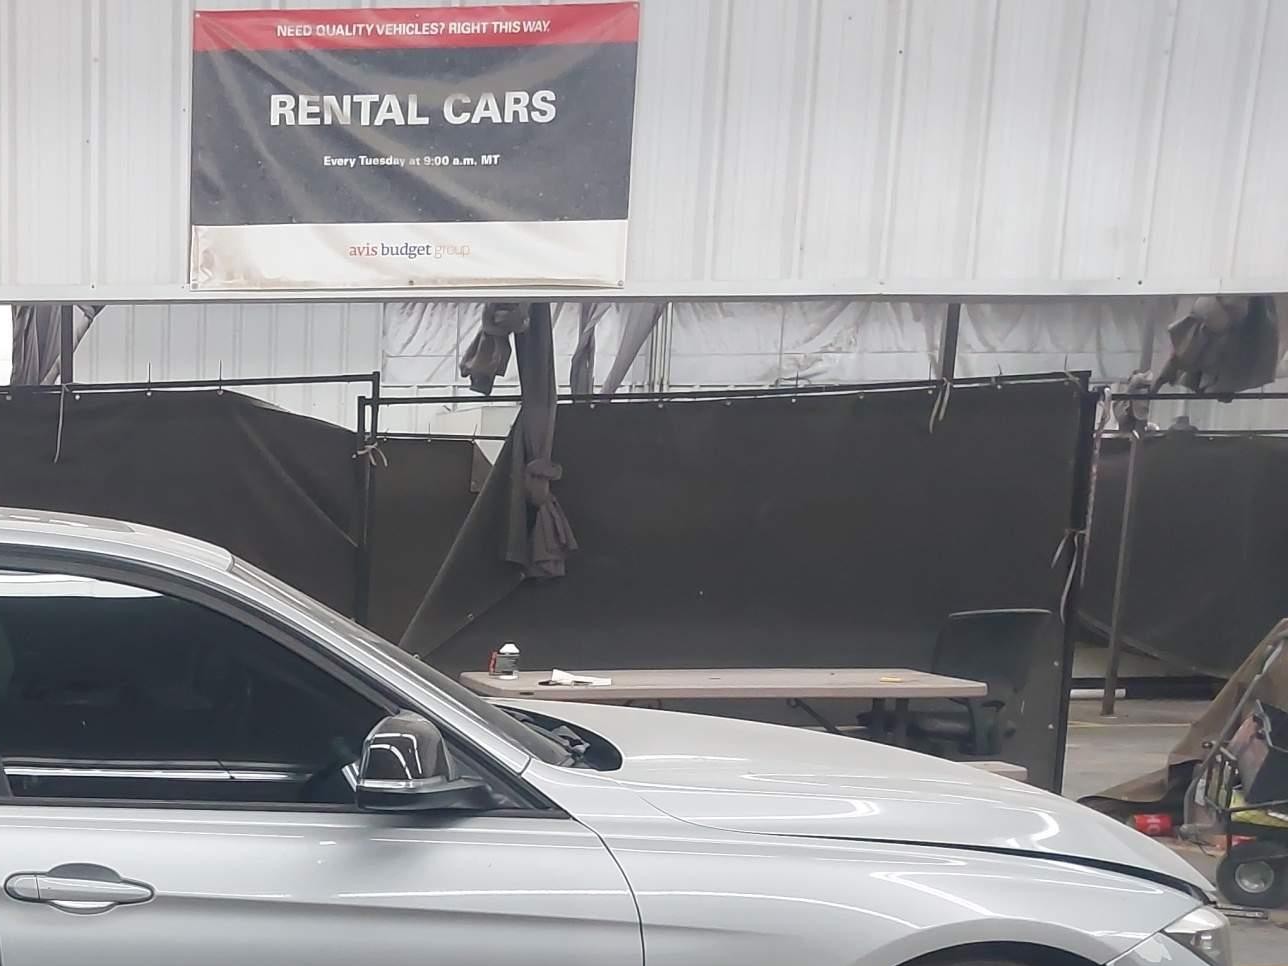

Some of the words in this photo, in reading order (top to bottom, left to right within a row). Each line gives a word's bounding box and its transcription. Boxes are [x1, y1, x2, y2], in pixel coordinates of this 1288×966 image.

[277, 25, 312, 37] NEED
[316, 24, 373, 37] QUALITY
[376, 22, 445, 35] VEHICLES?
[448, 22, 488, 34] RIGHT
[492, 21, 521, 33] THIS
[270, 94, 429, 127] RENTAL
[443, 90, 557, 124] CARS
[324, 156, 356, 168] Every
[359, 156, 405, 167] Tuesday
[409, 156, 420, 166] at
[424, 156, 449, 166] 9:00
[453, 156, 477, 166] a.m.
[481, 155, 500, 165] MT
[349, 243, 378, 257] avis
[381, 243, 432, 259] budget
